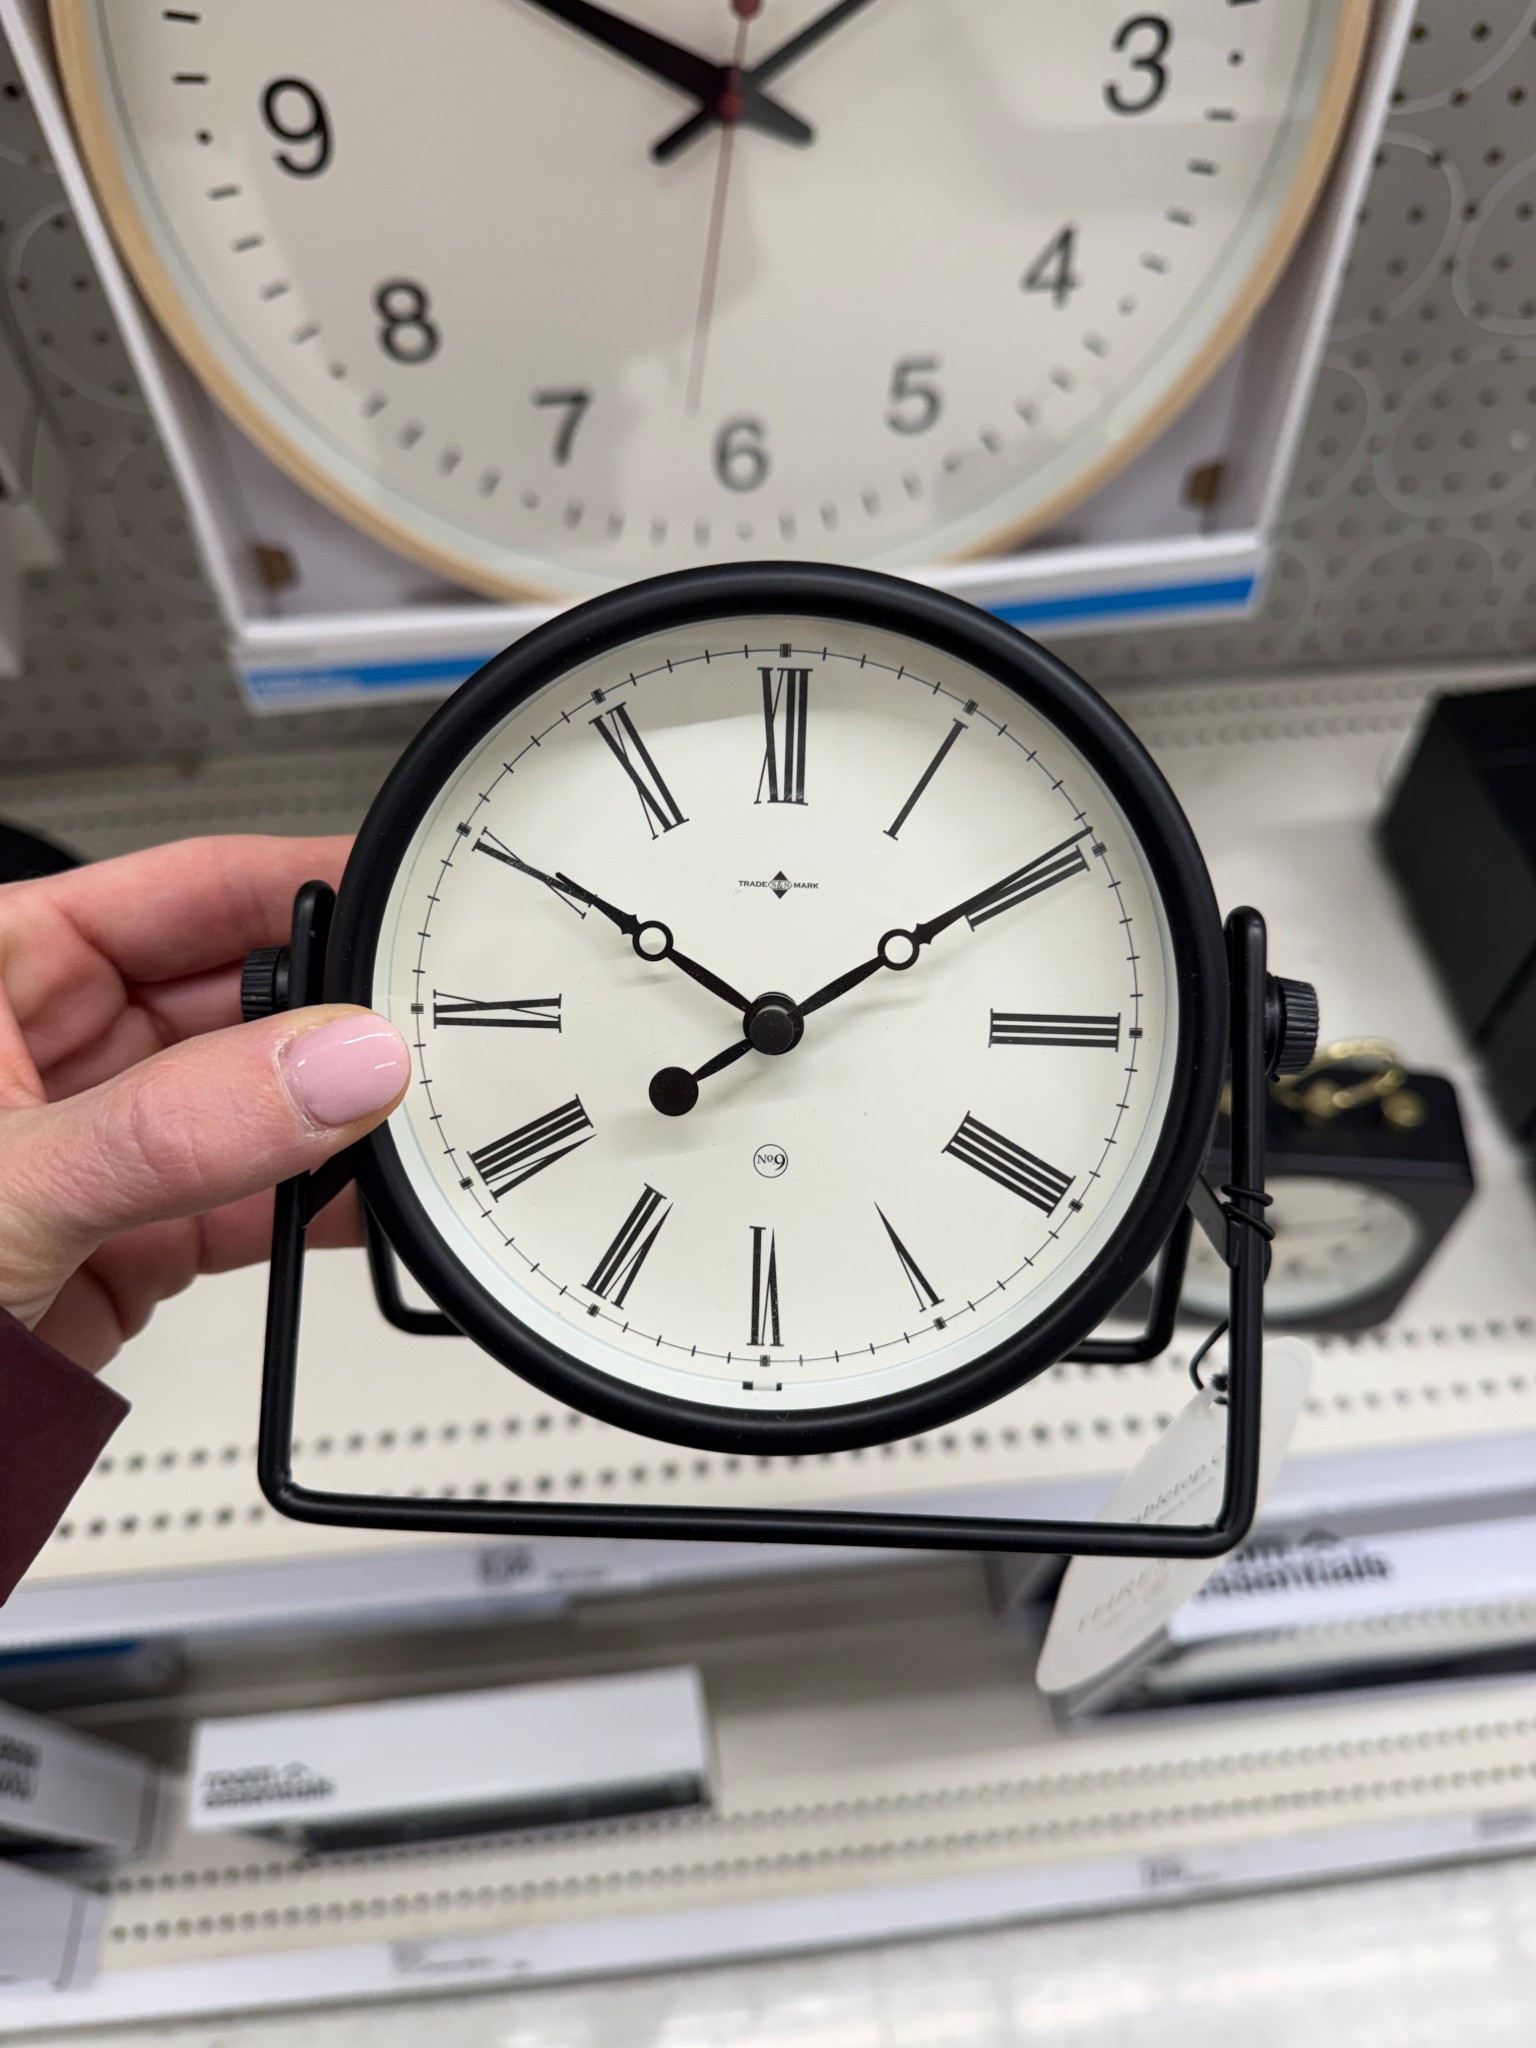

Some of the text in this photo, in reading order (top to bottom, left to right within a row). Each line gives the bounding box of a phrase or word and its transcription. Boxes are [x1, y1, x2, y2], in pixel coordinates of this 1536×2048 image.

[1102, 13, 1175, 116] 3
[259, 75, 336, 178] 9
[1021, 226, 1081, 308] 4
[372, 277, 442, 366] 8
[530, 386, 596, 470] 7
[887, 359, 943, 436] 5
[712, 416, 772, 495] 6
[588, 702, 689, 839] XI
[755, 667, 811, 806] XII
[738, 880, 768, 888] TRADE
[433, 989, 562, 1034] IX
[989, 1008, 1121, 1051] III
[468, 1095, 598, 1202] VIII
[942, 1111, 1075, 1217] IIII
[582, 1184, 674, 1309] VII
[746, 1226, 785, 1347] VI
[874, 1202, 943, 1312] V
